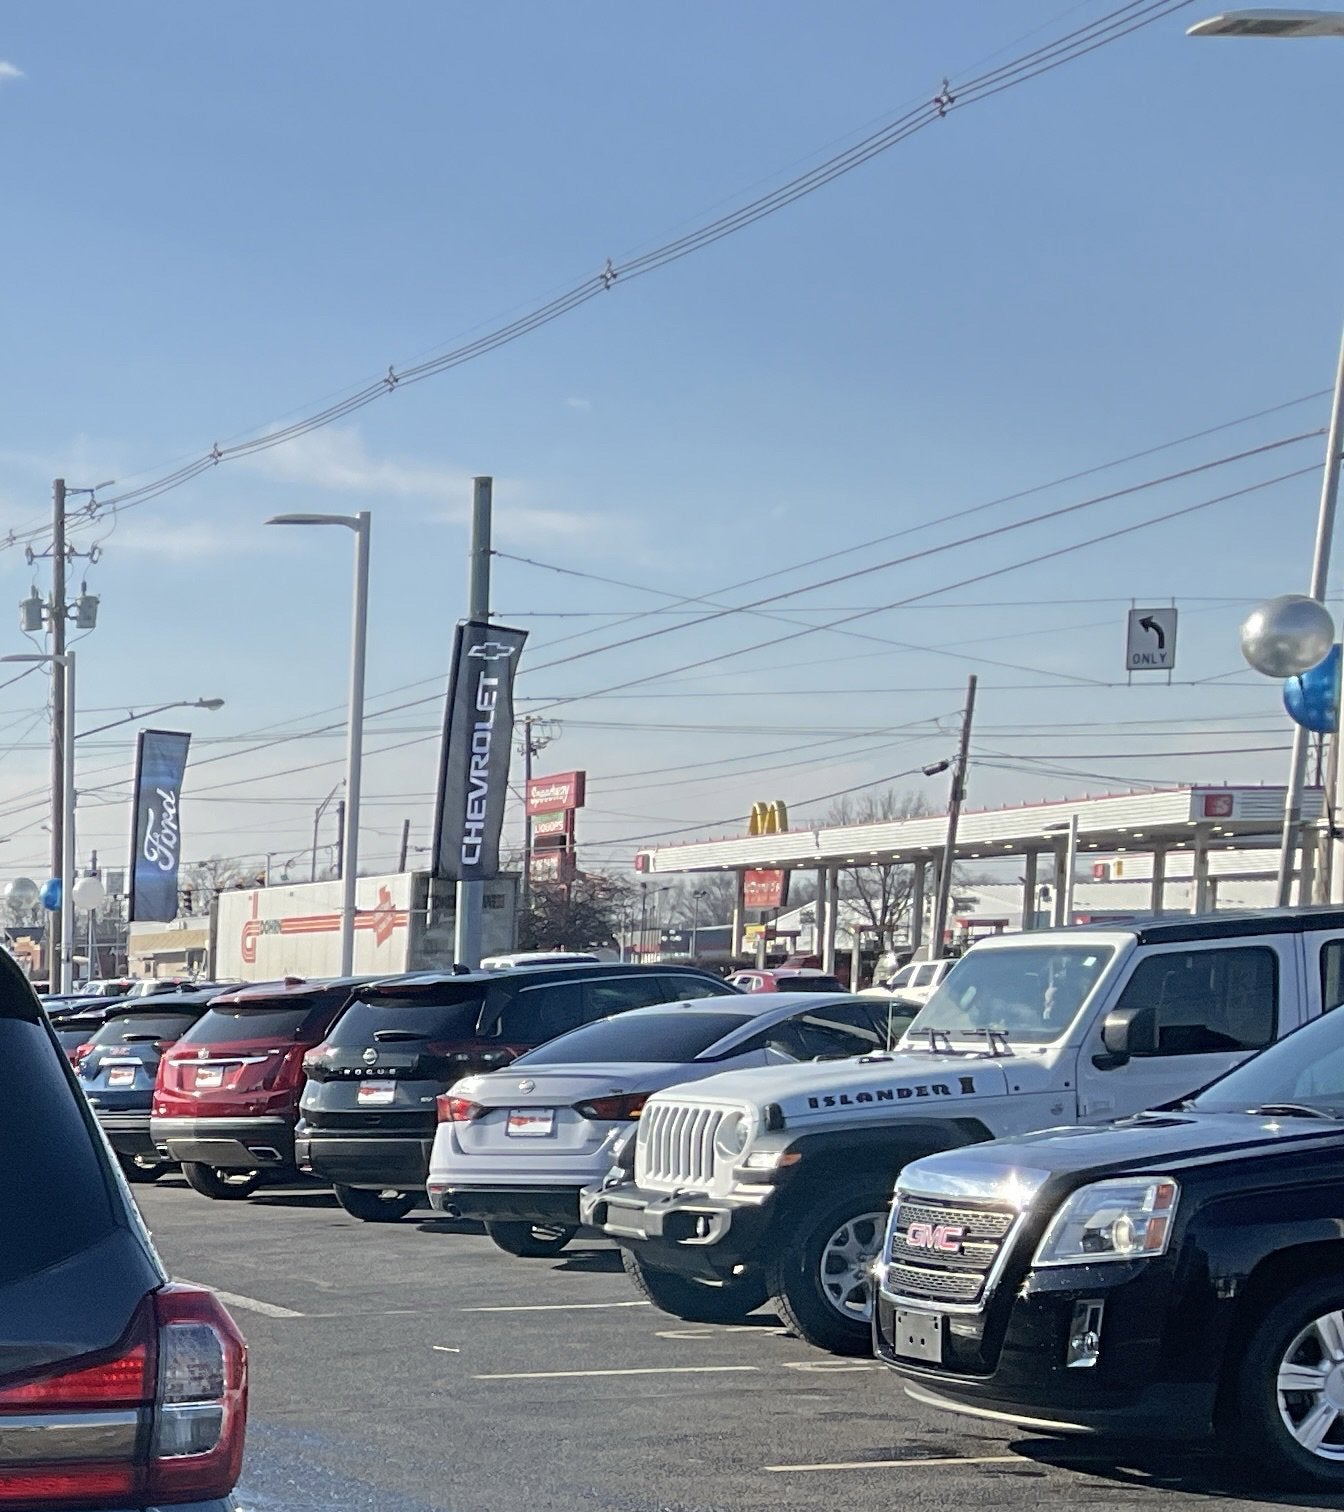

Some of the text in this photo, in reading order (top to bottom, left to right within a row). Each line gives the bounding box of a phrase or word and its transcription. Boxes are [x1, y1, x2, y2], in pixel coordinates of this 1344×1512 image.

[1132, 652, 1167, 665] ONLY
[462, 671, 499, 865] CHEVROLET
[144, 787, 178, 871] Ford
[808, 1084, 951, 1109] ISLANDER
[907, 1222, 963, 1252] GMC
